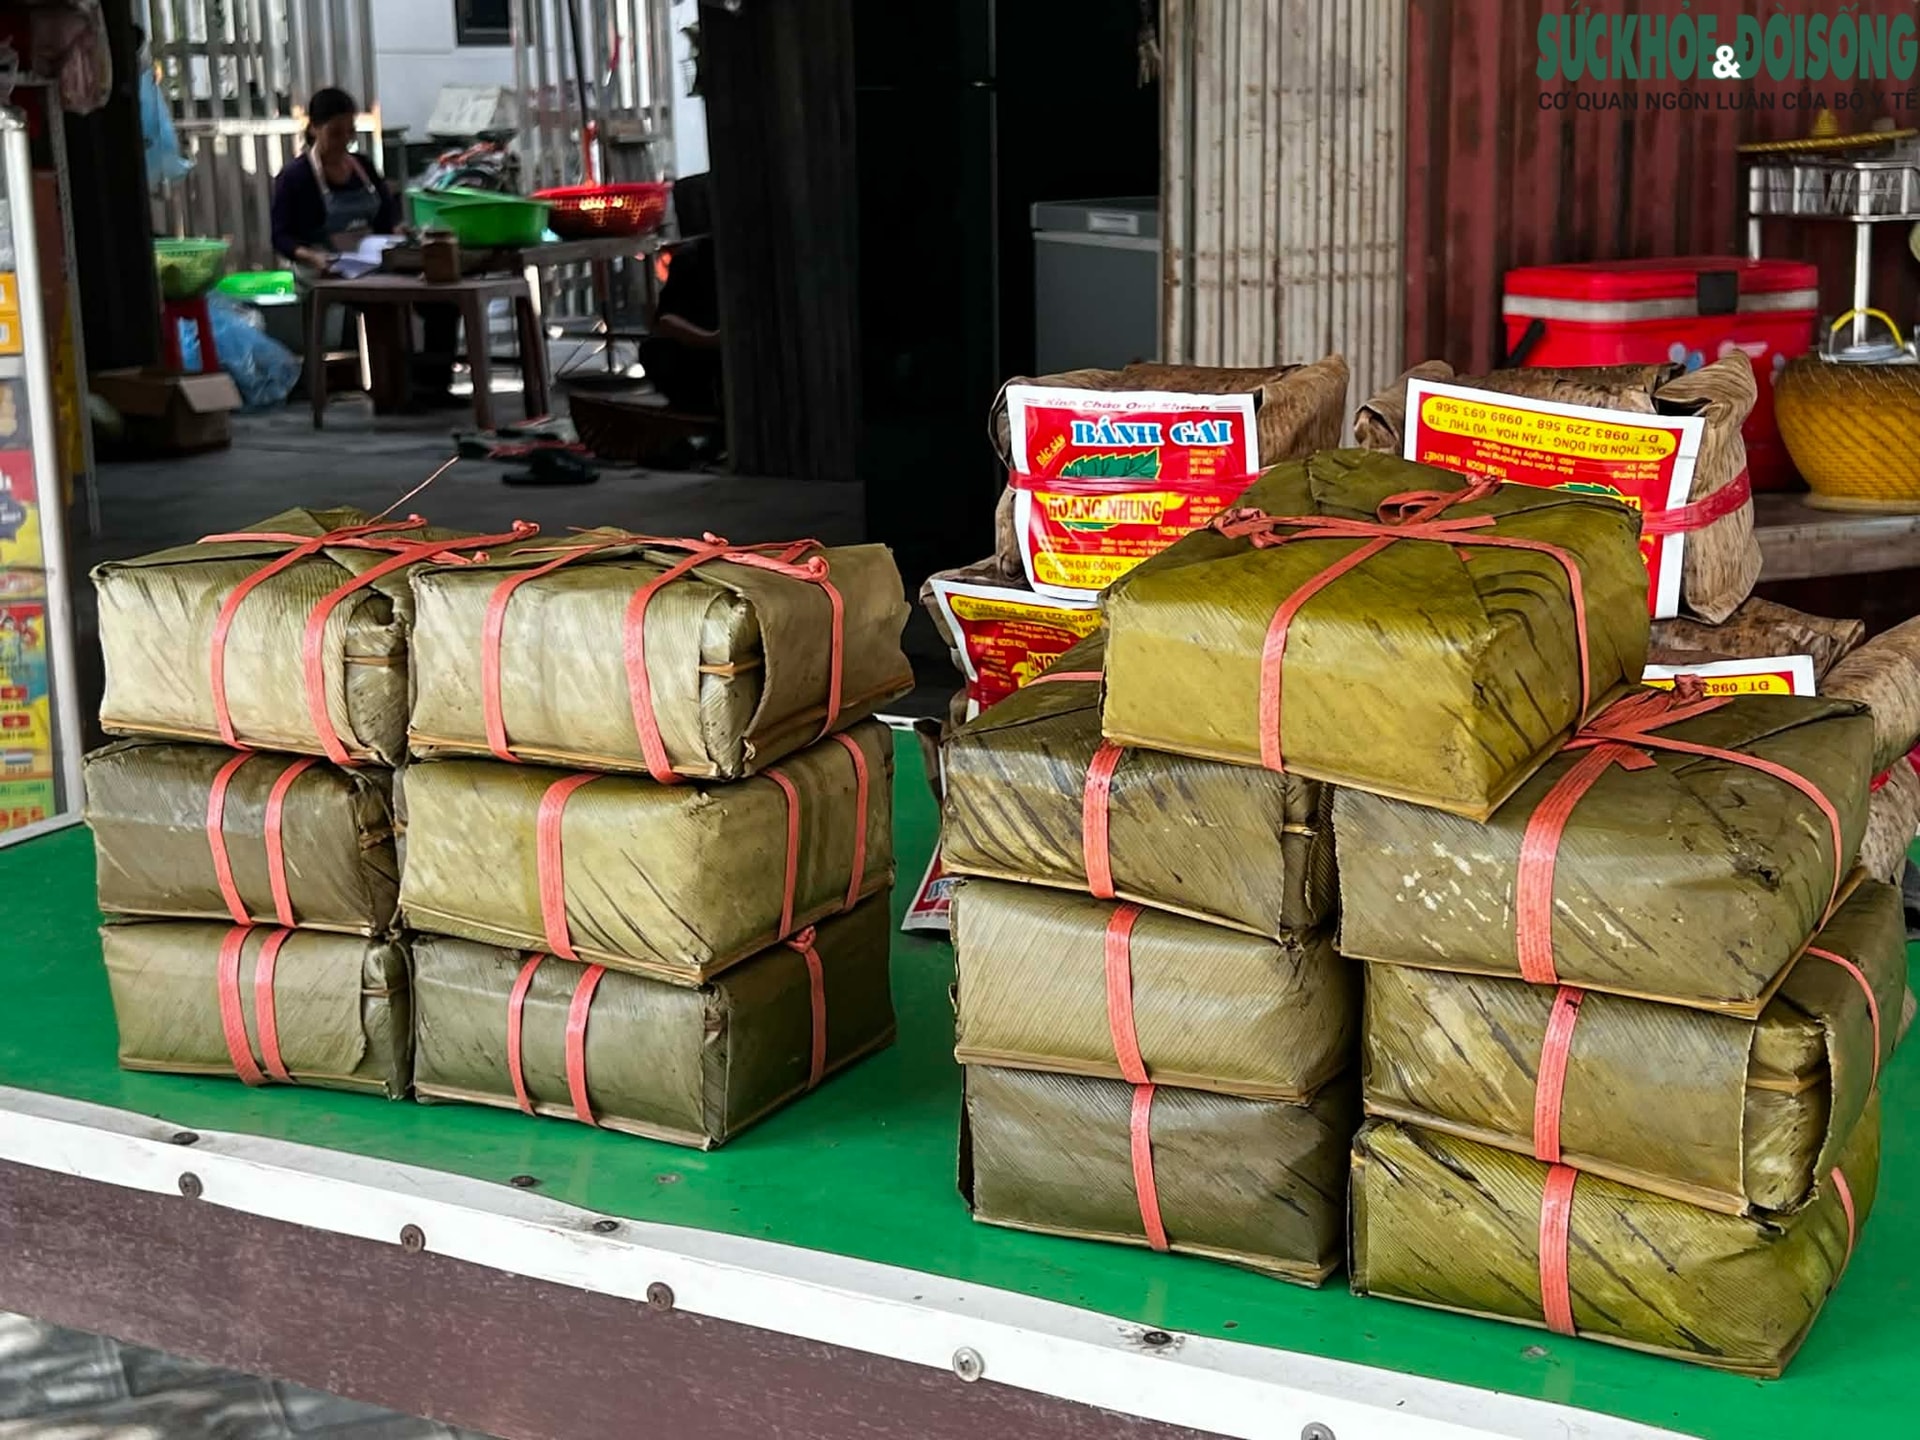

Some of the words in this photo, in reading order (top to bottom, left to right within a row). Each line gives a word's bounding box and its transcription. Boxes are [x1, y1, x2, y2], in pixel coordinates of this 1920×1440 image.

[1071, 415, 1165, 447] BÁNH
[1170, 419, 1233, 446] GAI
[1105, 499, 1162, 521] NHUNG
